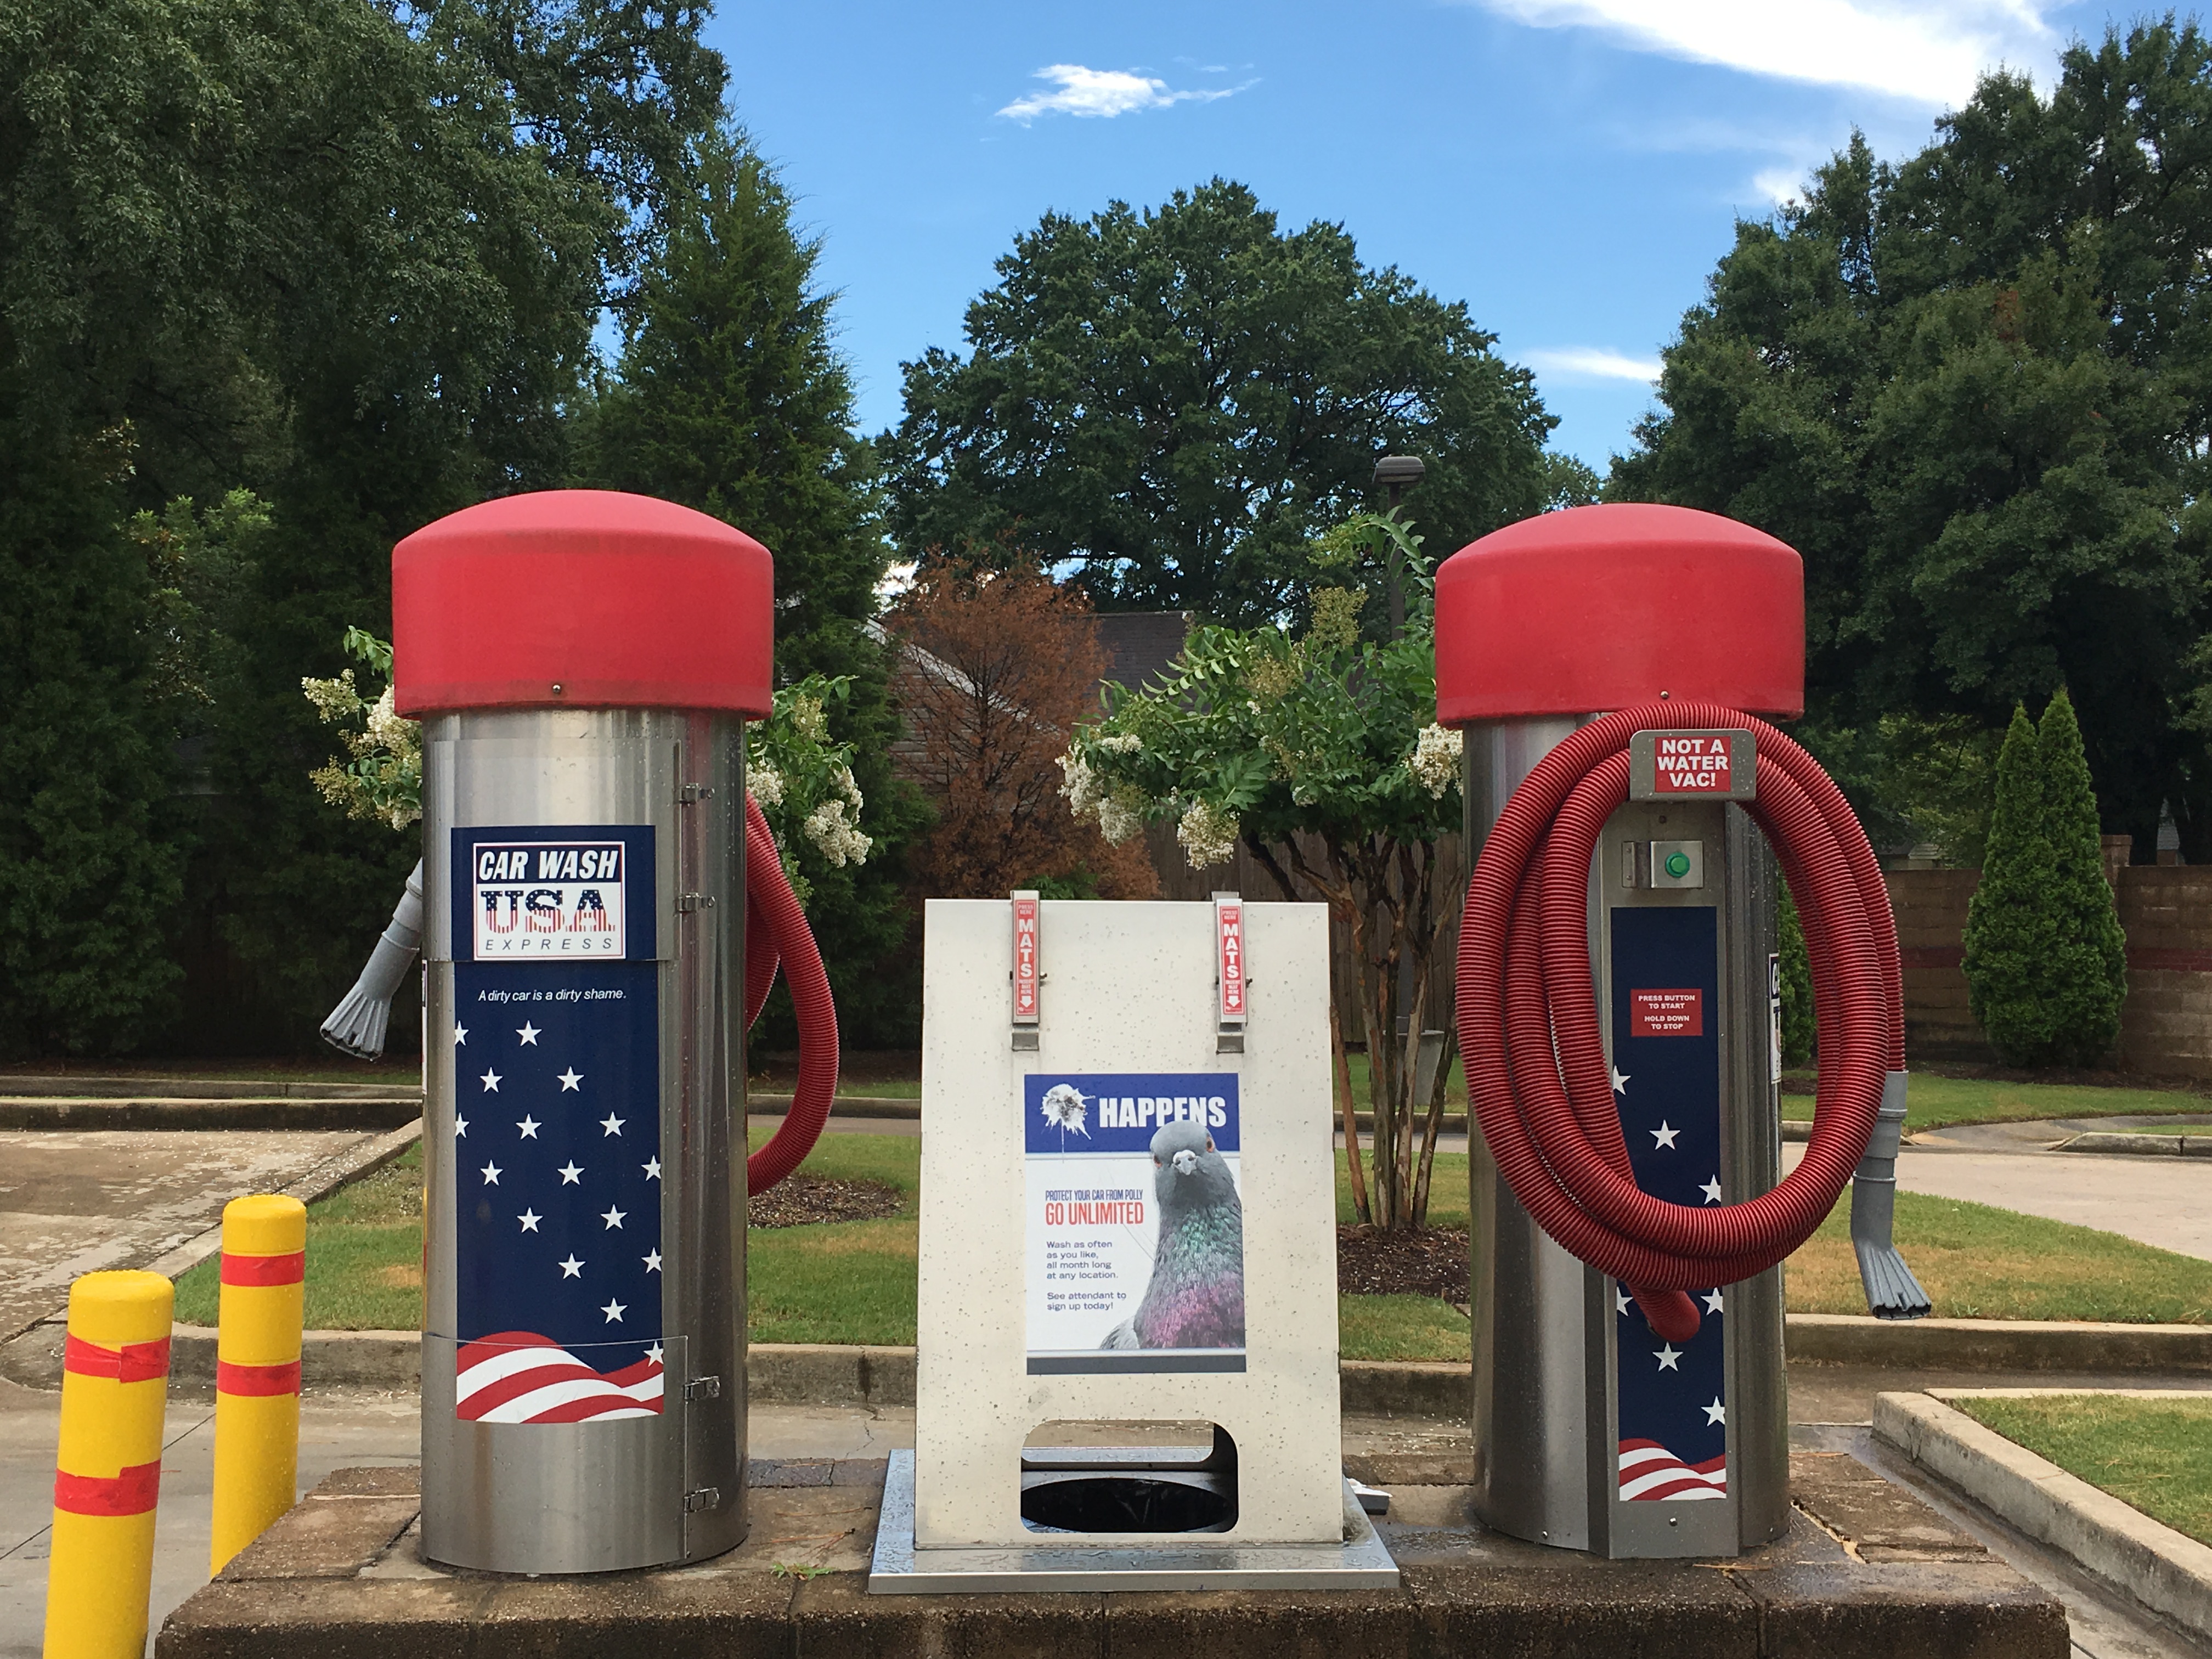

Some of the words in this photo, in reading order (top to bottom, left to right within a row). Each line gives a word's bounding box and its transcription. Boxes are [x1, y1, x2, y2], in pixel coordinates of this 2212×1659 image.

[1662, 739, 1704, 754] NOT
[1709, 739, 1724, 754] A
[1657, 755, 1729, 771] WATER
[1669, 772, 1716, 787] VAC!
[479, 850, 528, 881] CAR
[538, 850, 618, 879] WASH
[481, 889, 616, 934] USA
[485, 938, 612, 951] EXPRESS
[1018, 918, 1034, 978] MATS
[1223, 923, 1239, 979] MATS
[478, 990, 486, 1001] A
[488, 990, 511, 1004] dirty
[512, 991, 531, 1001] car
[532, 989, 543, 1001] is
[545, 991, 553, 1001] a
[555, 989, 582, 1003] dirty
[583, 988, 627, 1000] shame.
[1099, 1097, 1226, 1128] HAPPENS
[1045, 1190, 1073, 1201] PROTECT
[1074, 1190, 1091, 1201] YOUR
[1092, 1189, 1104, 1200] CAR
[1105, 1189, 1124, 1200] FROM
[1125, 1189, 1143, 1200] POLLY
[1046, 1202, 1064, 1226] GO
[1068, 1201, 1144, 1225] UNLIMITED
[1080, 1251, 1099, 1260] like,
[1092, 1261, 1111, 1269] long
[1047, 1292, 1065, 1300] See
[1047, 1302, 1066, 1311] sign
[1084, 1302, 1113, 1311] today!
